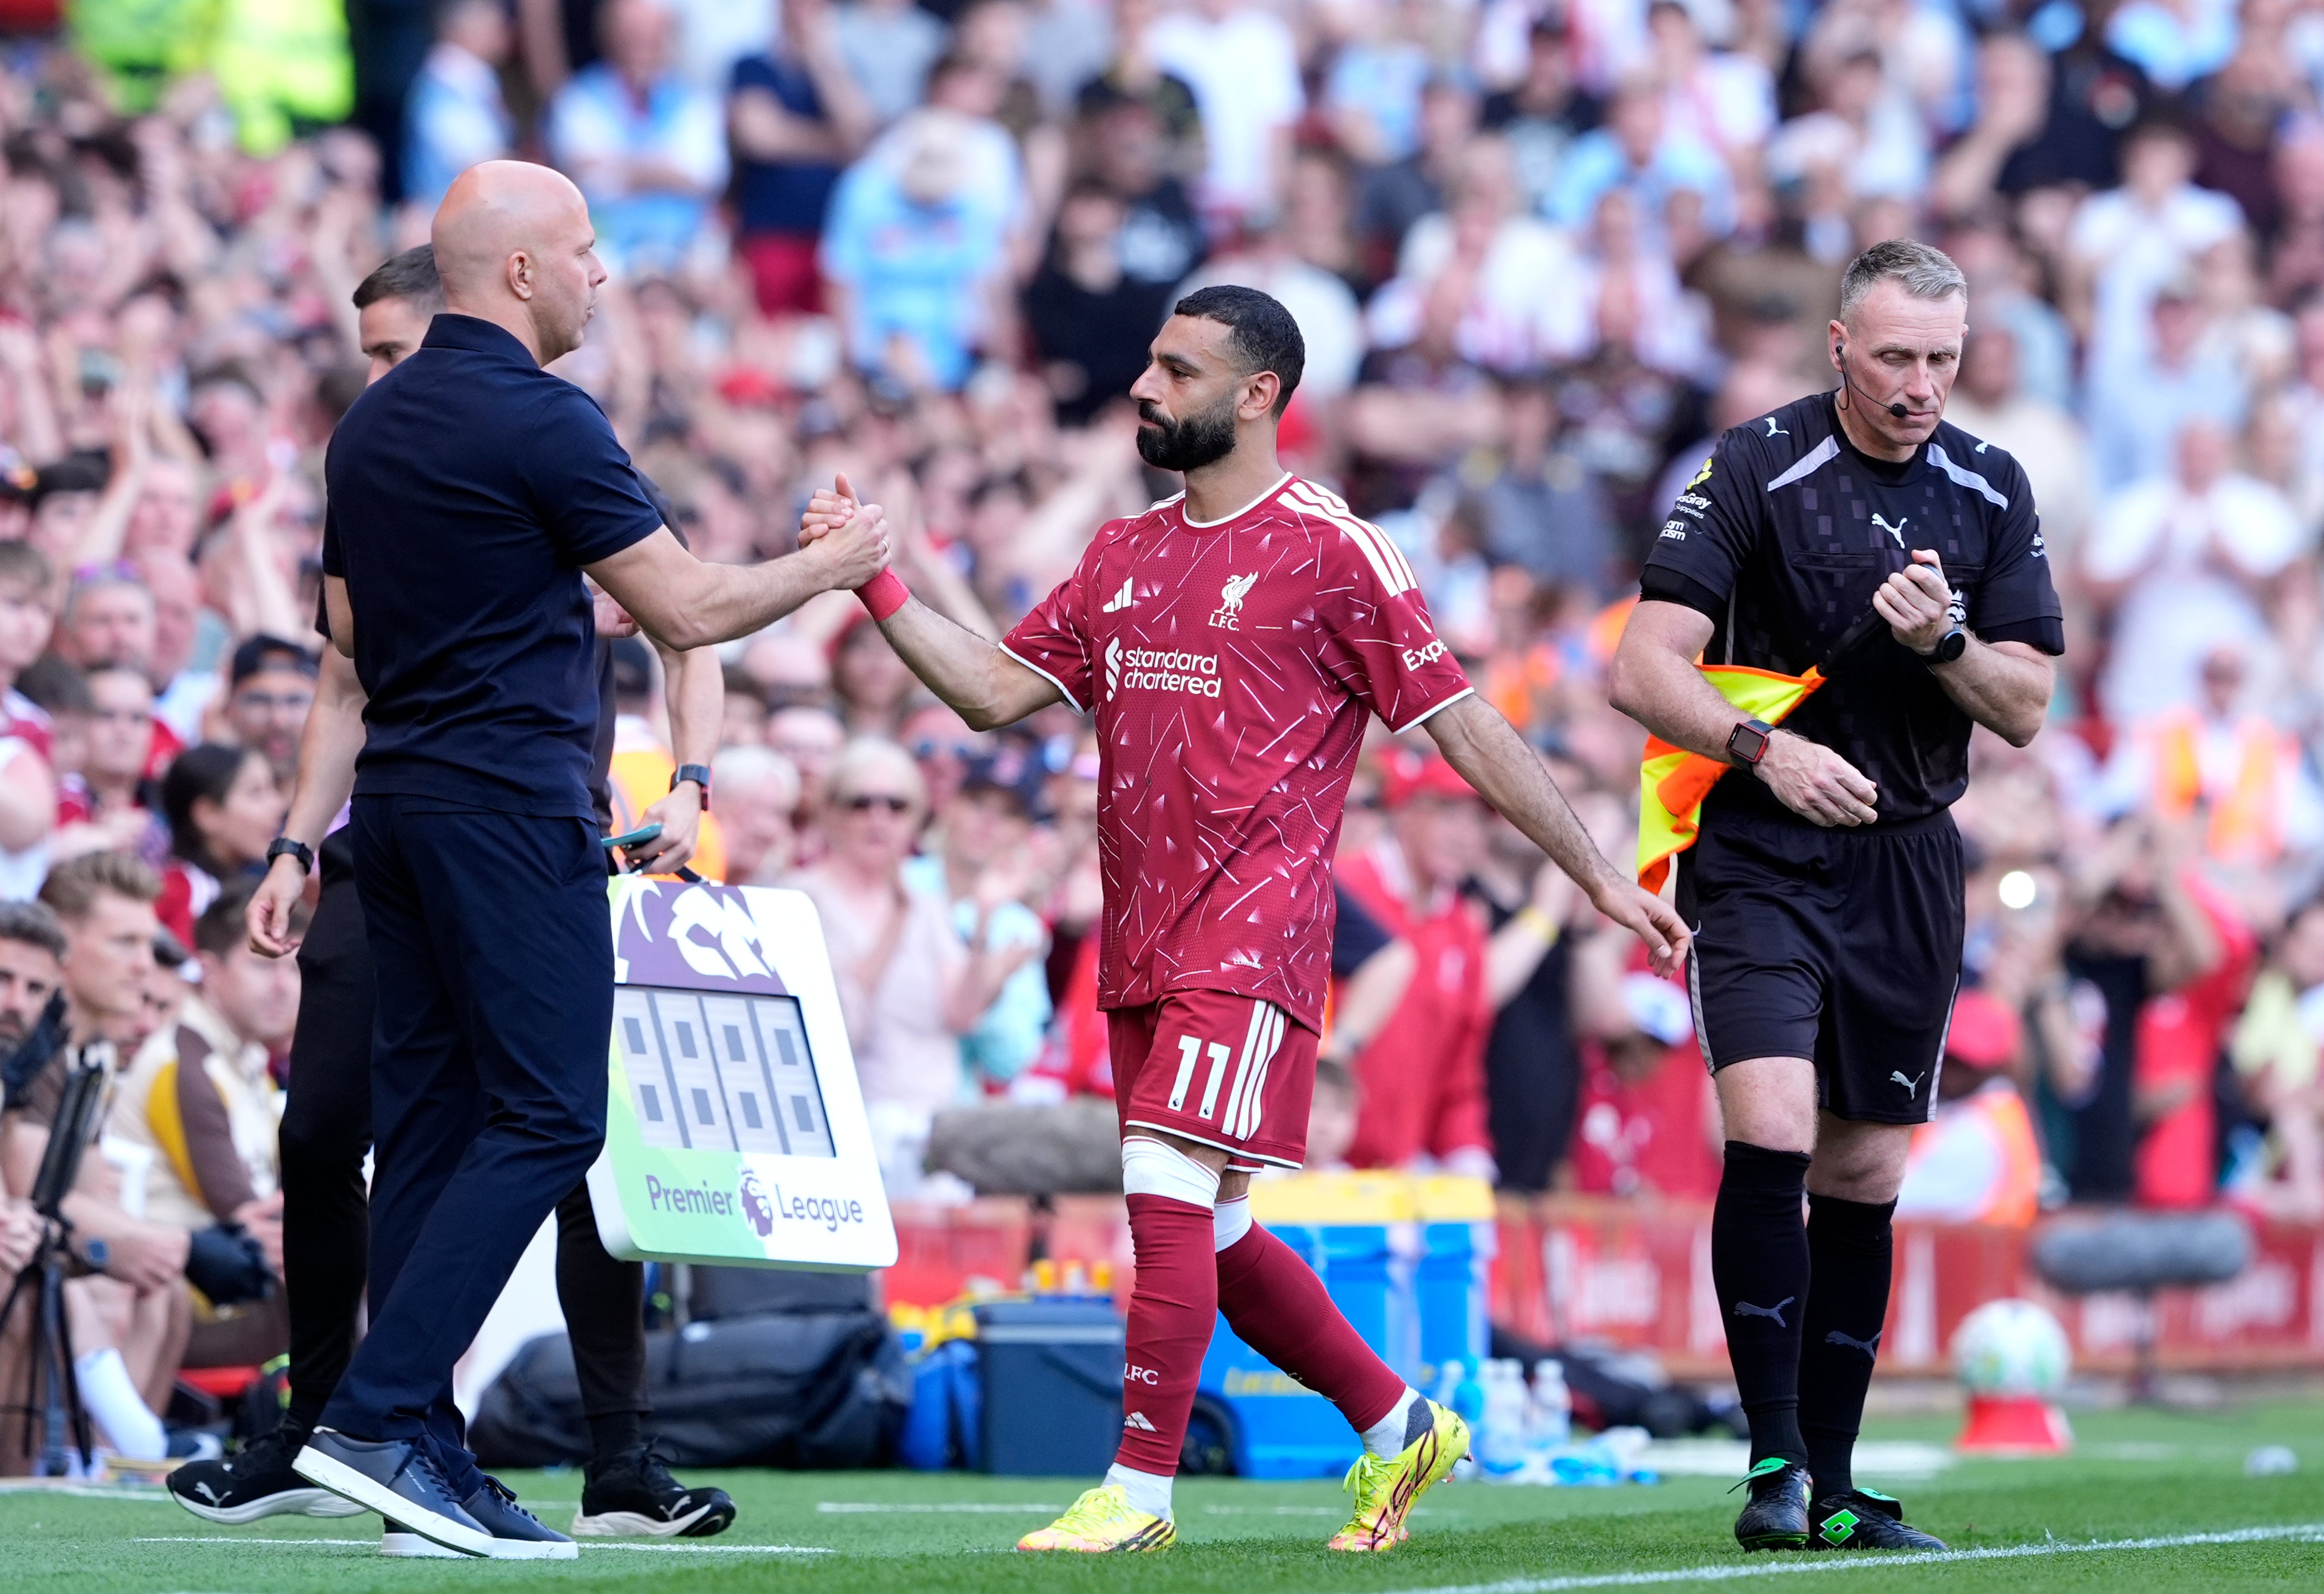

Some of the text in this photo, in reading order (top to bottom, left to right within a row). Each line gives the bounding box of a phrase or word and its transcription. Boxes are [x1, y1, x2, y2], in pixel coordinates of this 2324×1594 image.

[1125, 646, 1218, 676] standard
[1124, 667, 1222, 698] chartered
[1167, 1034, 1232, 1120] 11
[645, 1175, 863, 1233] Premier League
[1124, 1362, 1159, 1385] LFC
